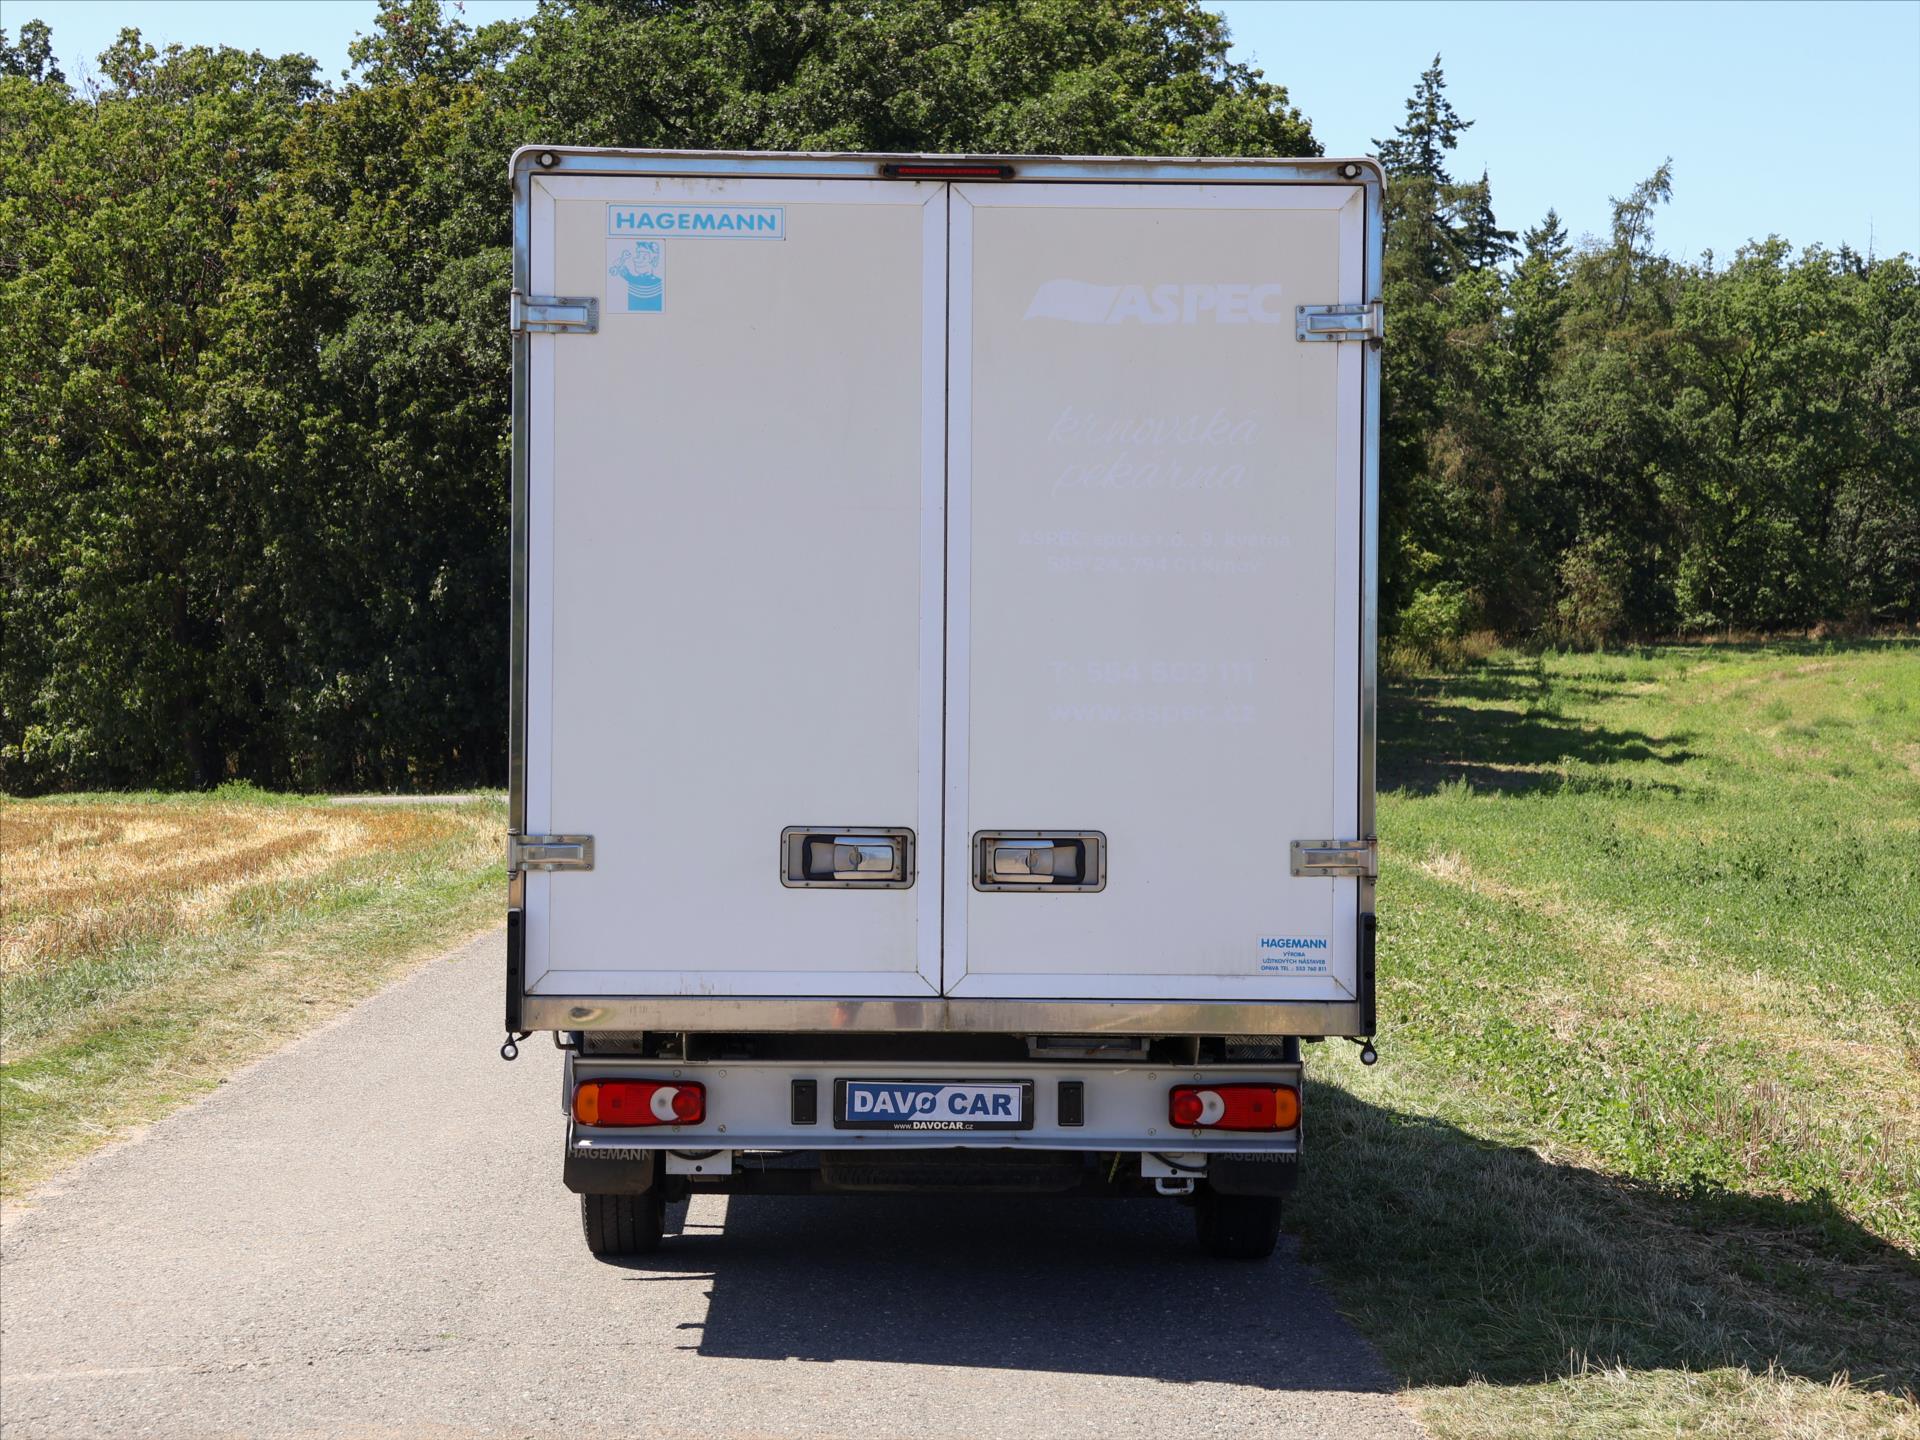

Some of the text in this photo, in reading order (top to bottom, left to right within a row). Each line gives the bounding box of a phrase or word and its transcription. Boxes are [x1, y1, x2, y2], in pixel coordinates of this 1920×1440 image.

[616, 212, 776, 231] HAGEMANN
[1105, 283, 1282, 325] ASPEC
[1261, 938, 1327, 949] HAGEMANN
[854, 1090, 1012, 1116] DAVO CAR
[893, 1121, 974, 1130] www.DAVOCAR.cz
[1217, 1152, 1297, 1164] AGEMANN
